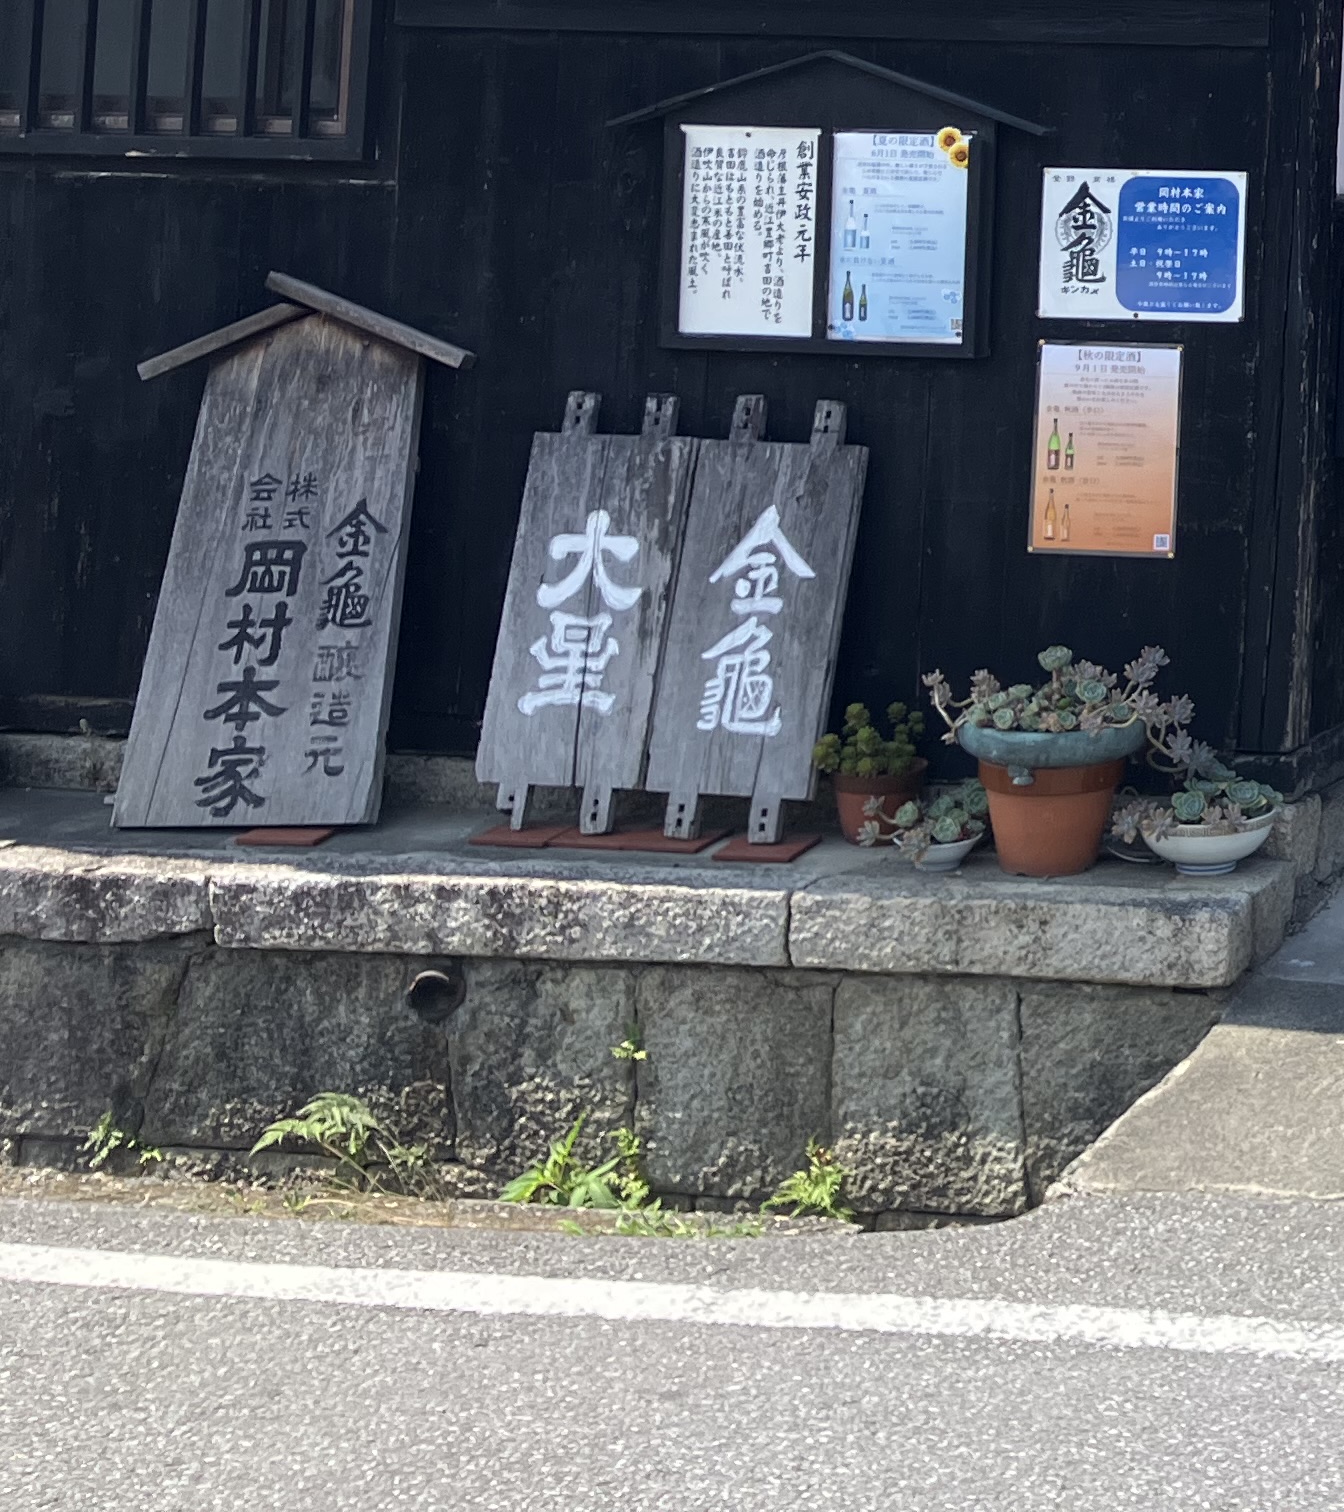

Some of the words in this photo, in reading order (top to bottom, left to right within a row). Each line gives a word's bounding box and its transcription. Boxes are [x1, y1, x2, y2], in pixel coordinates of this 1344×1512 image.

[793, 140, 814, 264] 創業安政元年
[1134, 201, 1227, 215] 営業時間のご案内
[1159, 187, 1205, 199] 岡村本家
[194, 540, 308, 819] 岡村本家
